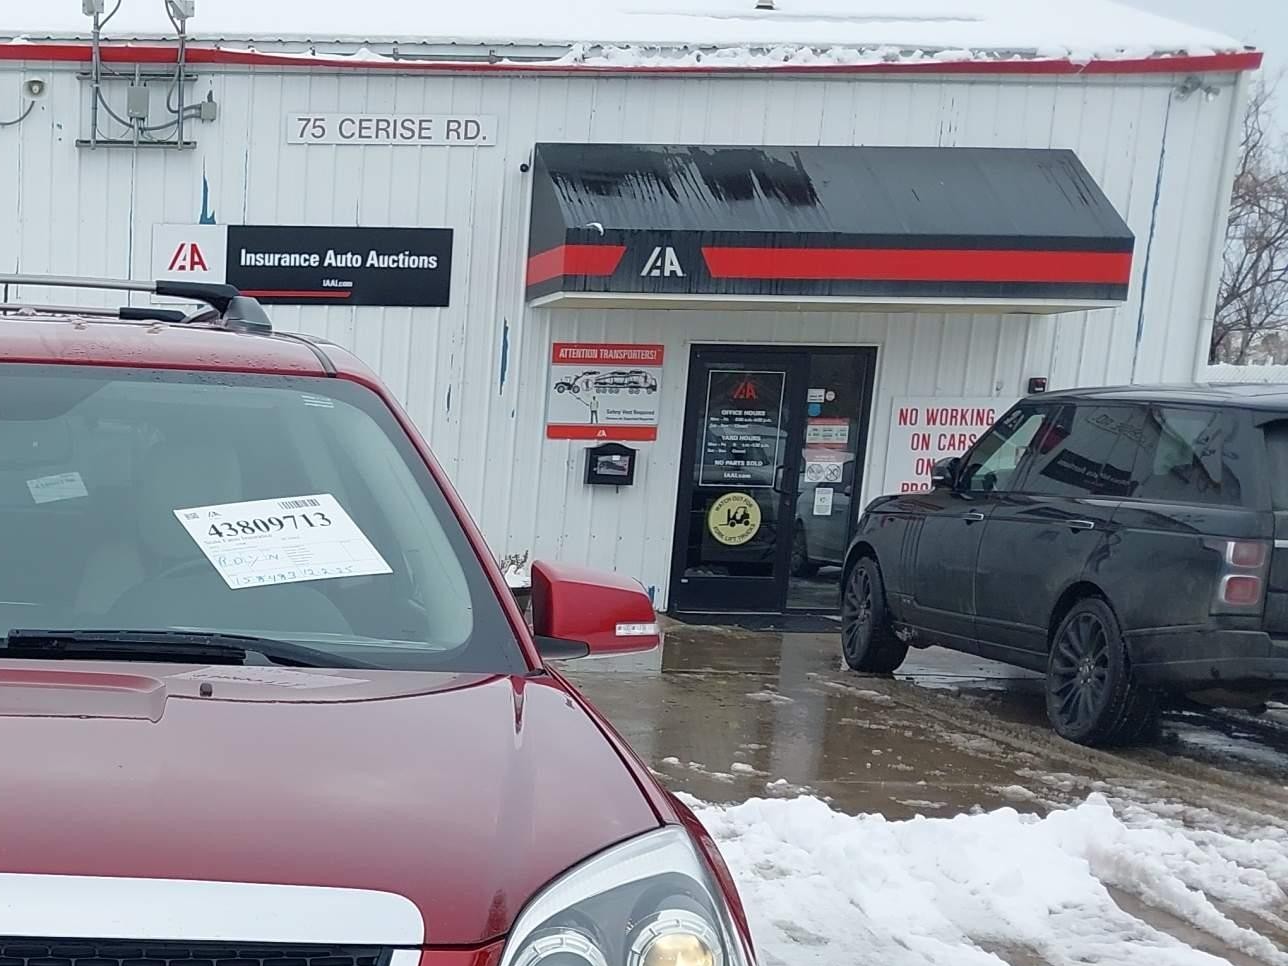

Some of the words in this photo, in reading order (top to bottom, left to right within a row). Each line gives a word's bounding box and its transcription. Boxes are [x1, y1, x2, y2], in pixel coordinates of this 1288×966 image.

[297, 117, 326, 139] 75
[338, 118, 433, 140] CERISE
[446, 119, 487, 141] RD.
[240, 248, 320, 268] Insurance
[323, 249, 362, 268] Auto
[365, 250, 438, 269] Auctions
[558, 347, 598, 359] ATTENTION
[599, 349, 657, 360] TRANSPORTERS!
[898, 407, 919, 426] NO
[926, 408, 996, 426] WORKING
[910, 433, 931, 451] ON
[937, 433, 977, 451] CARS
[208, 512, 332, 538] 43809713
